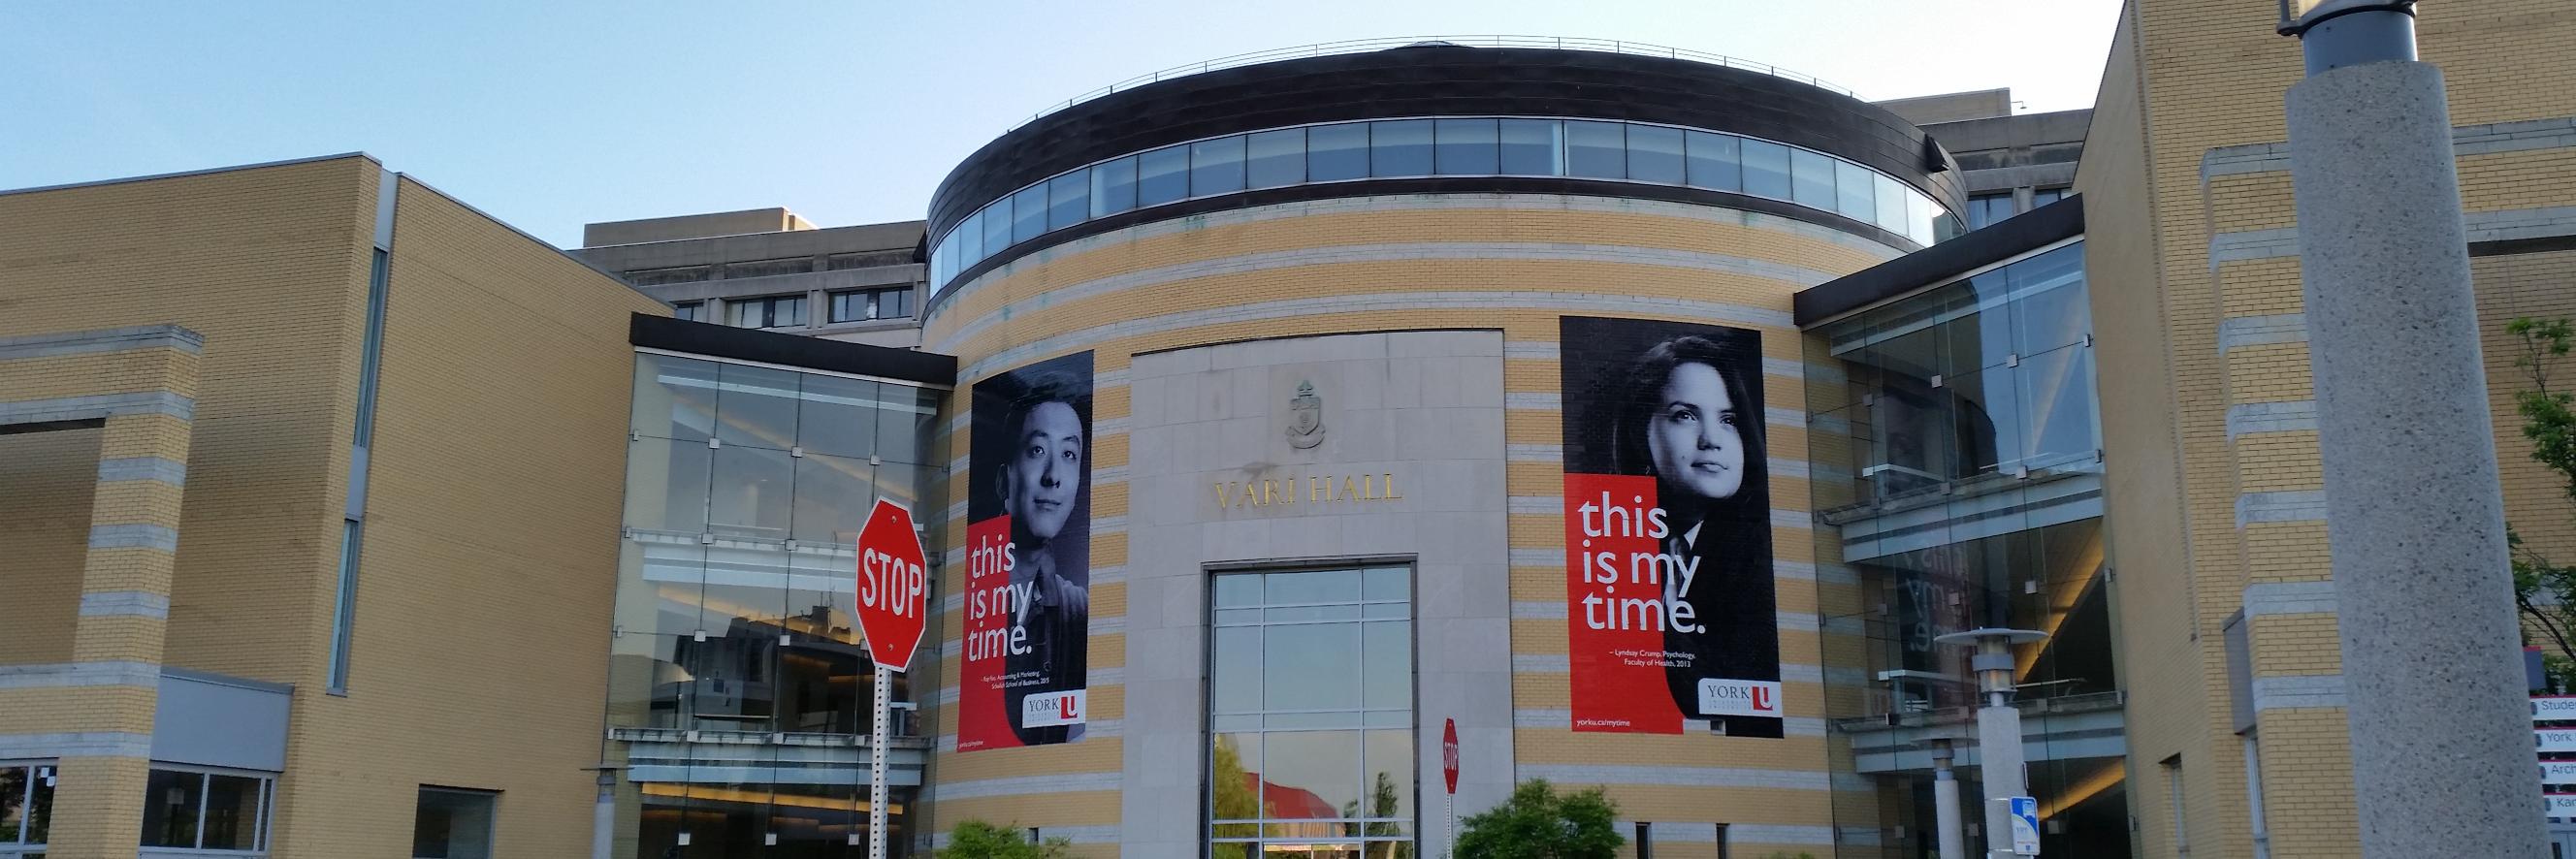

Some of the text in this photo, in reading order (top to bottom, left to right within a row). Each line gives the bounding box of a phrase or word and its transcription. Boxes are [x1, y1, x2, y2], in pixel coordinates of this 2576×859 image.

[1214, 472, 1404, 509] VARI HALL
[1578, 491, 1669, 539] this
[971, 533, 1015, 579] this
[1582, 539, 1701, 598] is my
[861, 547, 921, 619] STOP
[970, 581, 1034, 623] is my
[1582, 586, 1706, 635] time.
[968, 620, 1033, 661] time.
[1624, 658, 1646, 667] Faculty
[1028, 698, 1059, 713] YORK
[1707, 684, 1750, 699] YORK
[2541, 699, 2576, 711] Stude
[1576, 718, 1630, 728] yorku.ca/mytime
[2547, 732, 2572, 743] York
[1444, 742, 1459, 771] STOP
